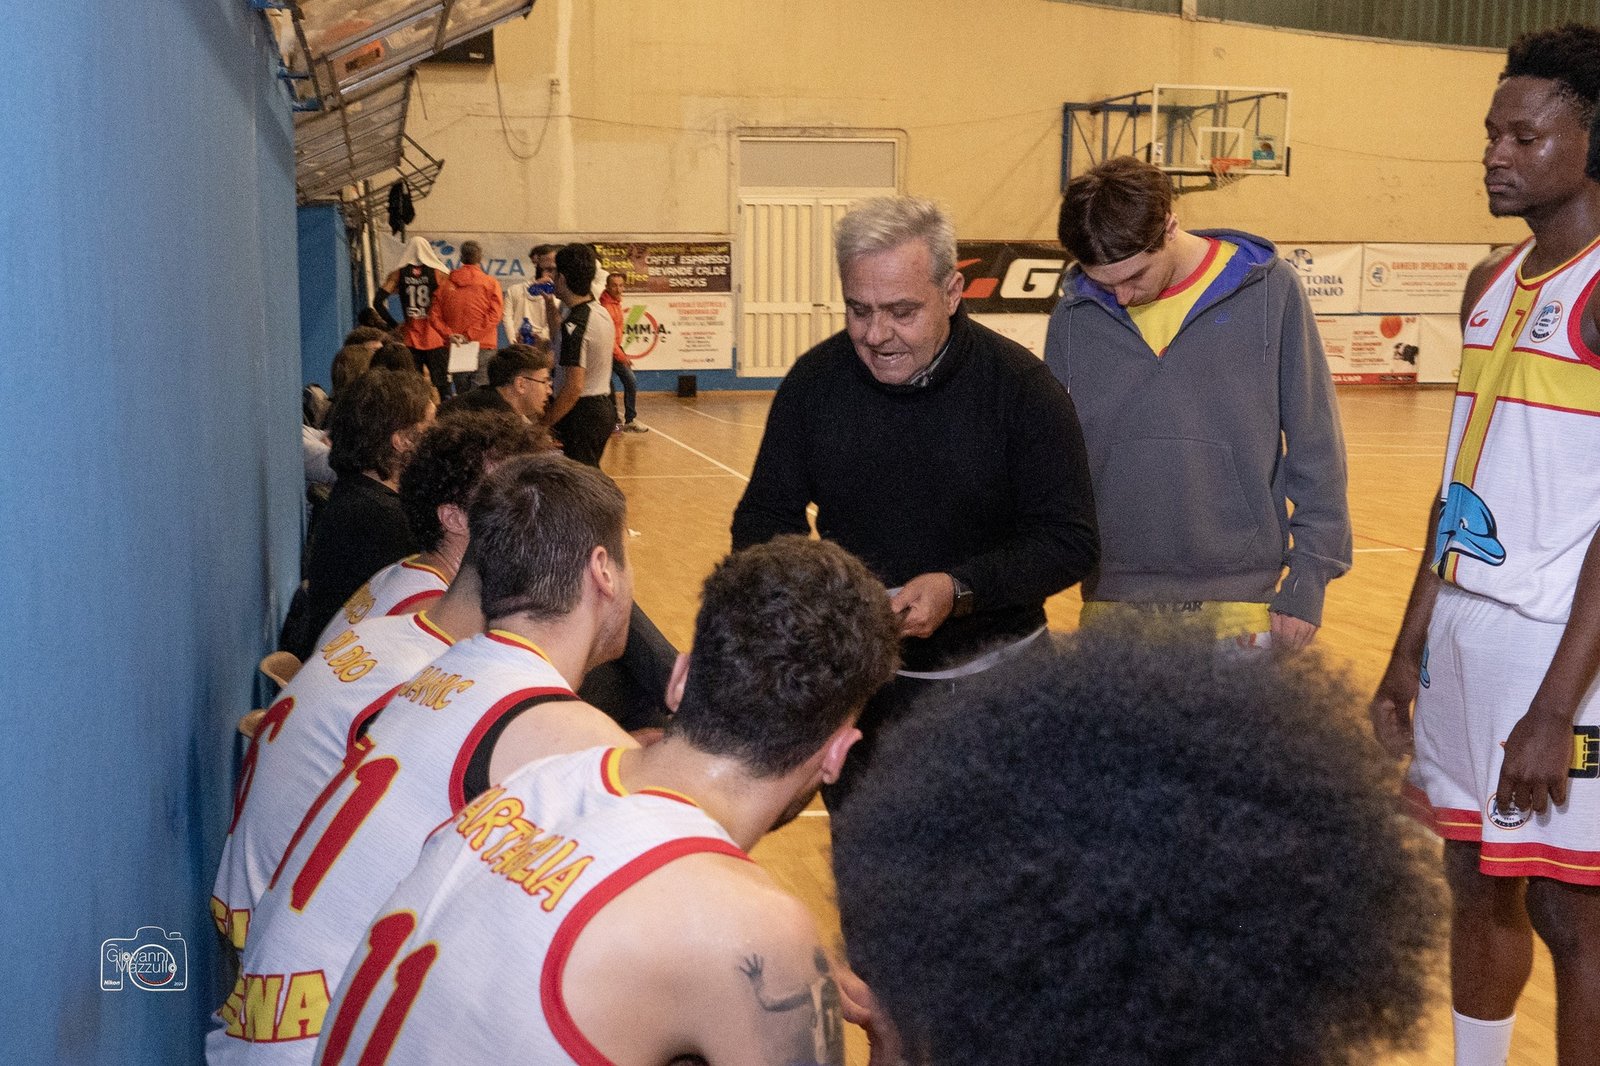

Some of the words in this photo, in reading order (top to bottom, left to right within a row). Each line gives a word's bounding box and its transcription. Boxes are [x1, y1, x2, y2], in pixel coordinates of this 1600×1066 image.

[680, 254, 731, 264] ESPRESSO
[648, 266, 693, 276] BEVANDE
[695, 266, 727, 276] CALDE
[668, 277, 708, 288] SNACKS
[1000, 258, 1065, 299] G
[405, 284, 431, 308] 18
[1304, 287, 1345, 297] INAIO
[319, 908, 440, 1066] 11
